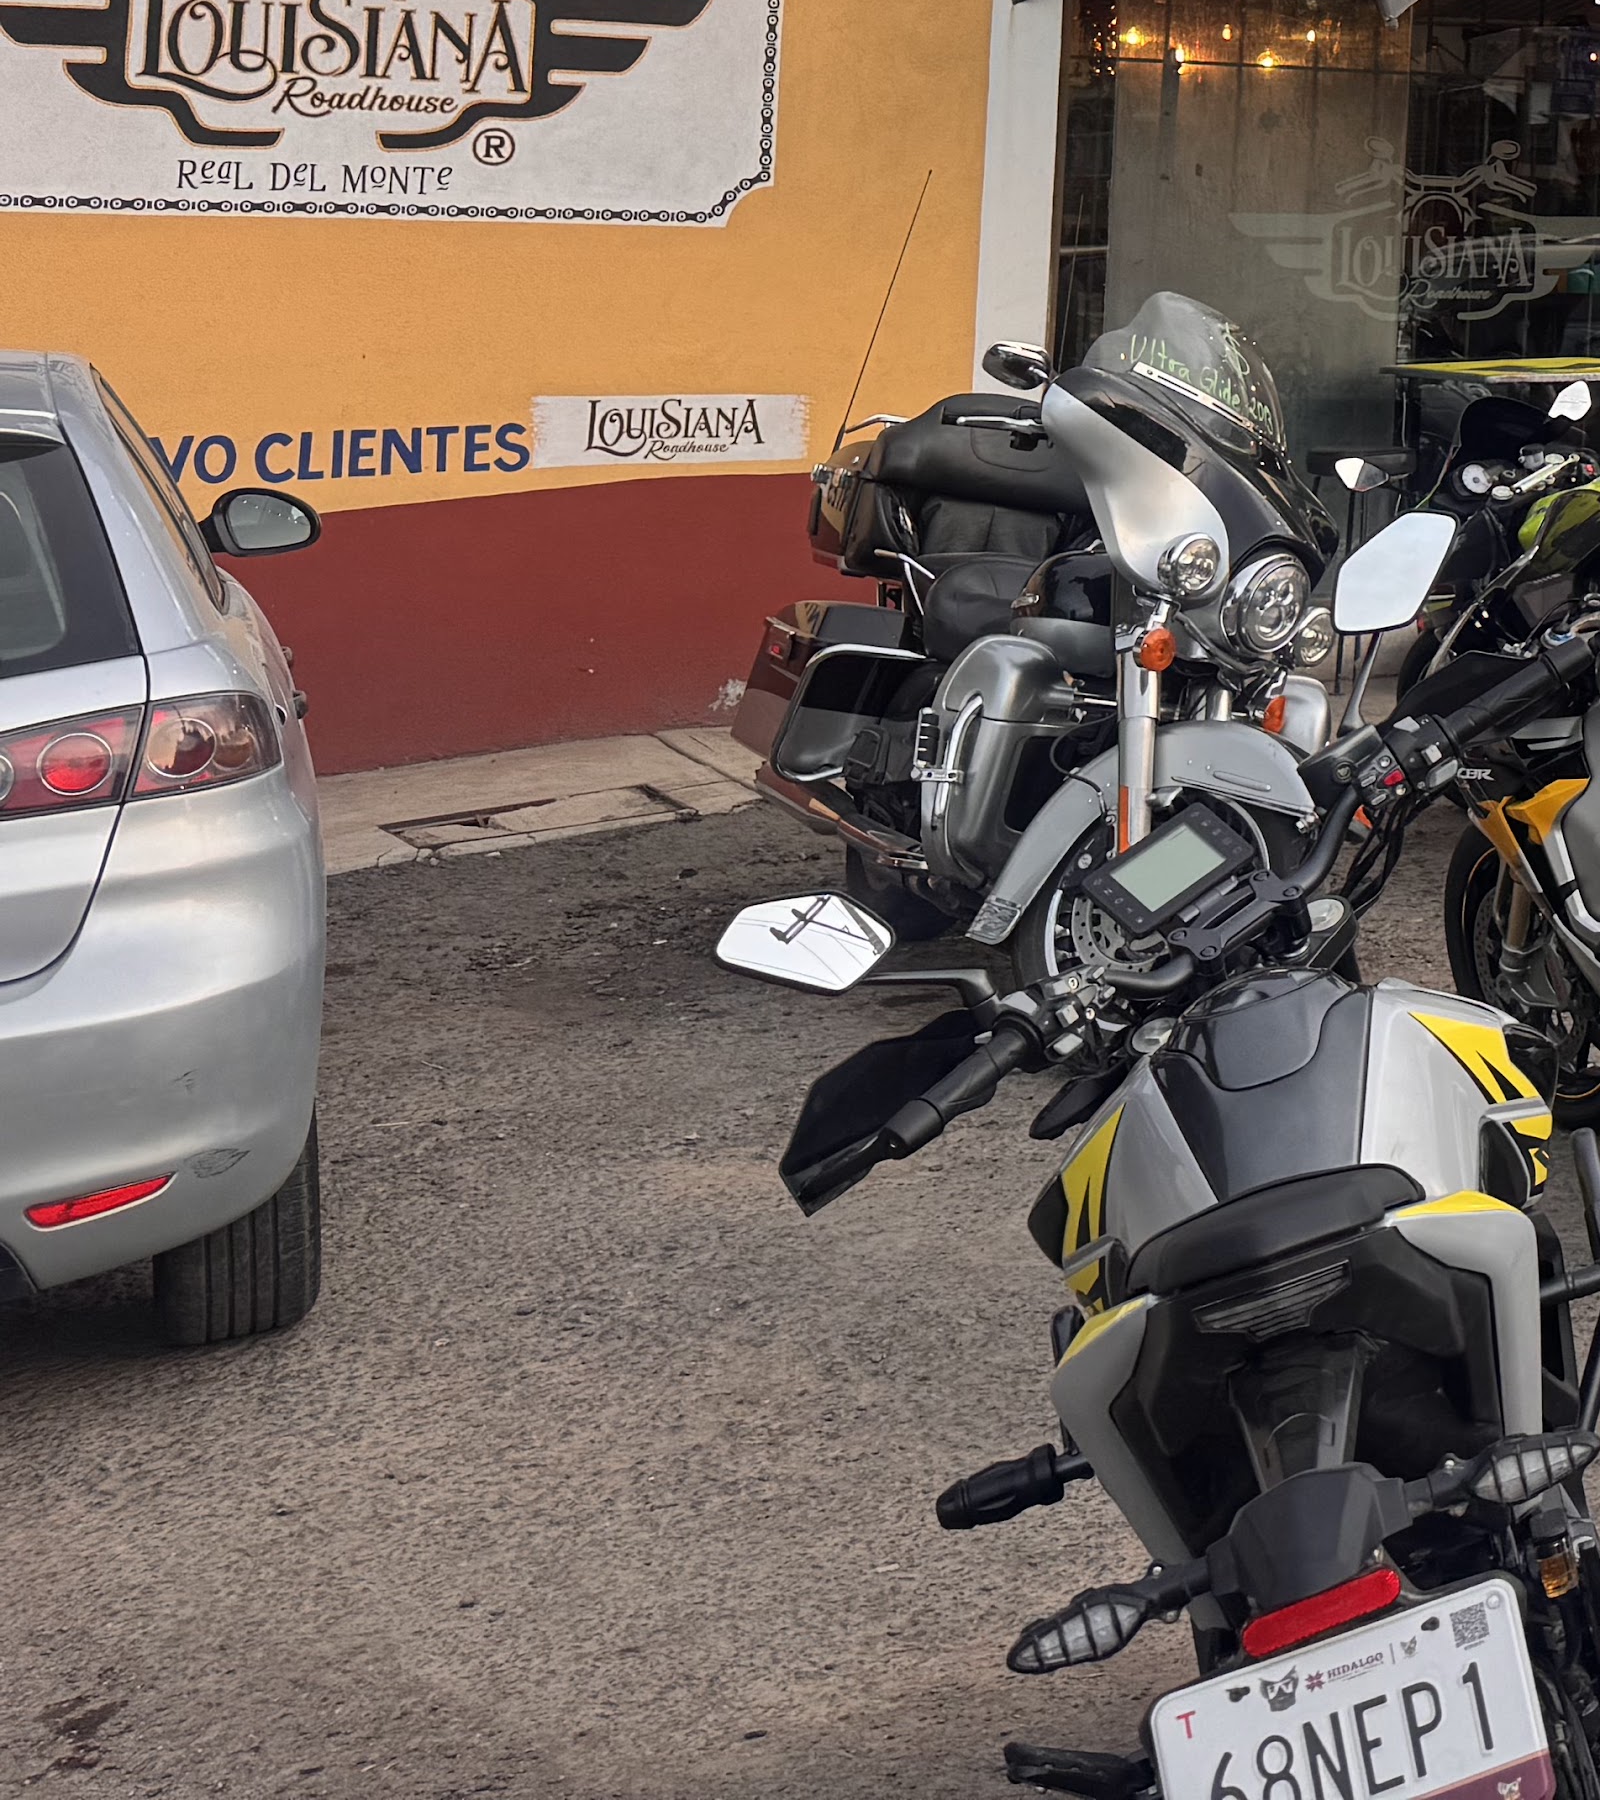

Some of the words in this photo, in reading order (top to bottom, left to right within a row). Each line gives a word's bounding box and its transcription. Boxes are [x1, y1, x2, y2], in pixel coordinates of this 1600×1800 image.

[273, 76, 459, 118] Roadhouse
[1336, 226, 1533, 296] LOUISIANA
[1130, 334, 1192, 383] Ultra
[1201, 367, 1241, 410] Glide
[585, 398, 765, 457] LOUISIANA
[645, 439, 729, 461] Roadhouse
[254, 424, 530, 483] CLIENTES
[1457, 767, 1495, 781] CBR
[1326, 1652, 1384, 1679] HIDALGO
[1176, 1711, 1197, 1740] T
[1210, 1661, 1494, 1800] 68NEP1
